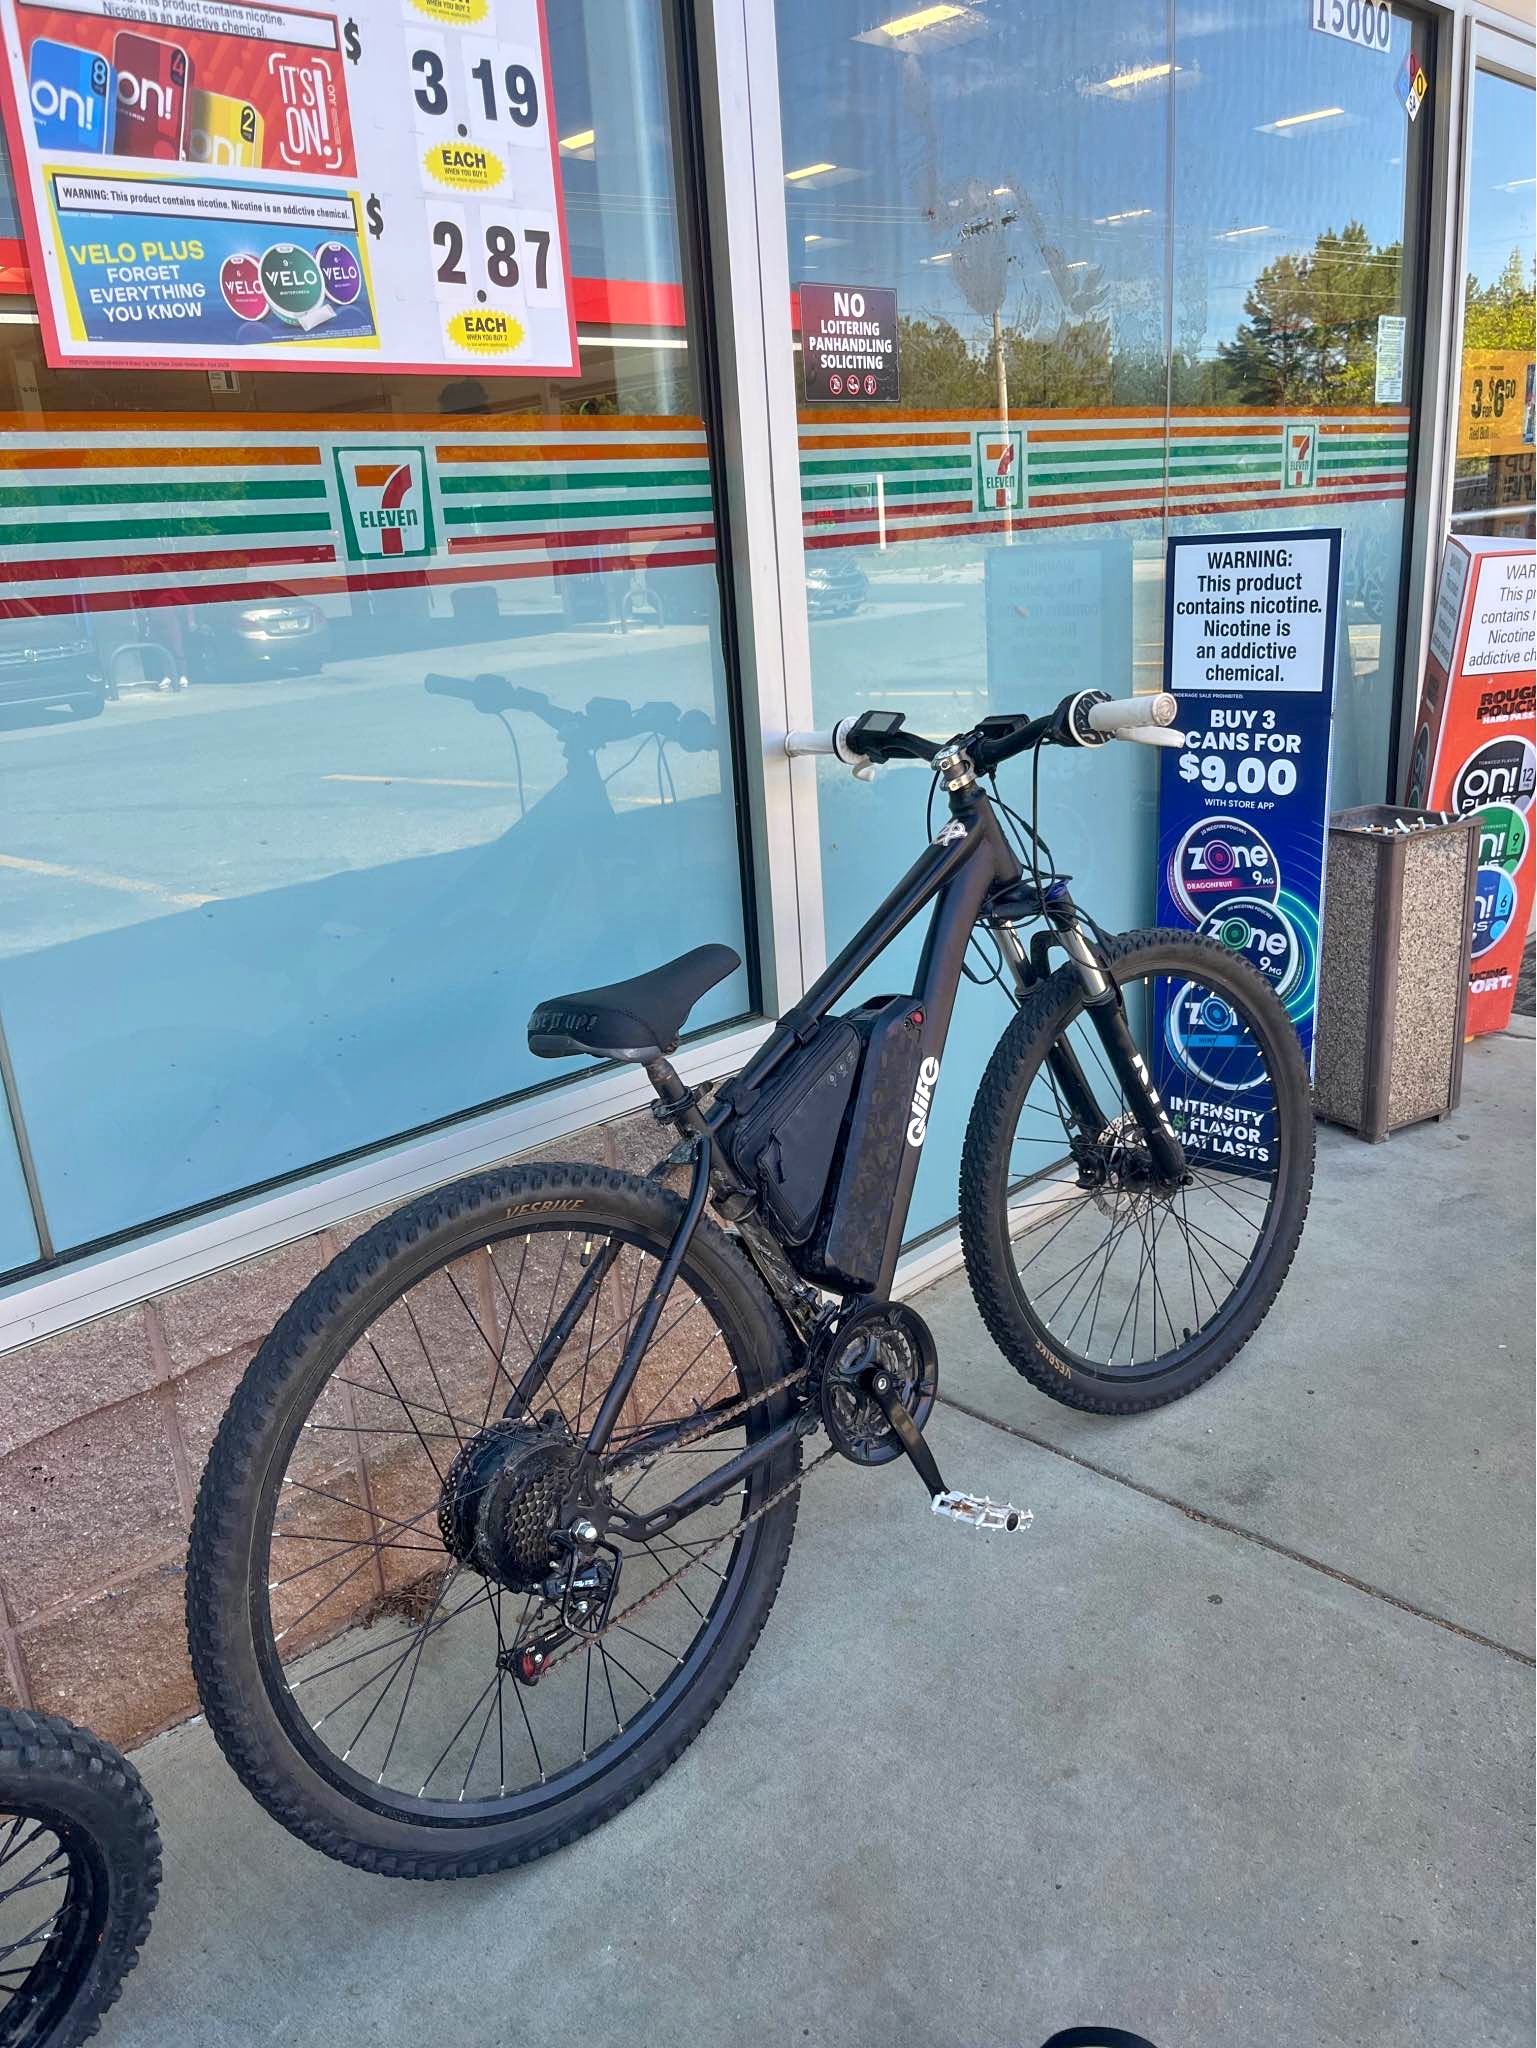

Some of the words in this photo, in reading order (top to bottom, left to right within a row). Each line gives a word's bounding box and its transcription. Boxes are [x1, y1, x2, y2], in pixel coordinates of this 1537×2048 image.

[102, 3, 147, 20] Nicotine
[149, 12, 158, 22] is
[160, 13, 174, 24] an
[175, 14, 219, 31] addictive
[222, 22, 268, 38] chemical.
[202, 4, 244, 19] contains
[245, 9, 286, 26] nicotine.
[1317, 0, 1390, 48] 15000
[93, 60, 105, 85] 8
[172, 52, 184, 76] 4
[279, 65, 313, 106] IT'S
[344, 17, 362, 65] $
[412, 49, 539, 138] 3.19
[31, 80, 94, 131] on!
[117, 70, 173, 120] on!
[242, 109, 254, 132] 2
[442, 150, 486, 169] EACH
[63, 187, 109, 201] WARNING:
[110, 190, 128, 203] This
[130, 193, 161, 205] product
[162, 195, 196, 207] contains
[197, 198, 230, 210] nicotine.
[231, 201, 263, 212] Nicotine
[272, 206, 282, 214] an
[283, 205, 315, 217] addictive
[316, 208, 350, 220] chemical.
[70, 242, 137, 266] VELO
[142, 239, 205, 262] PLUS
[366, 193, 384, 240] $
[433, 220, 550, 303] 2.87
[106, 264, 180, 284] FORGET
[265, 270, 318, 287] VELO
[323, 266, 357, 281] VELO
[89, 282, 206, 304] EVERYTHING
[102, 304, 143, 323] YOU
[146, 302, 202, 320] KNOW
[833, 291, 865, 318] NO
[464, 316, 507, 332] EACH
[820, 320, 880, 336] LOITERING
[809, 336, 892, 353] PANHANDLING
[820, 354, 883, 370] SOLICITING
[1471, 379, 1483, 419] 3
[1292, 435, 1310, 486] 7
[986, 444, 1015, 508] 7
[354, 464, 413, 555] 7
[1207, 549, 1293, 570] WARNING:
[1197, 574, 1231, 593] This
[1236, 573, 1302, 595] product
[1500, 586, 1523, 602] This
[1176, 597, 1245, 615] contains
[1250, 595, 1322, 614] nicotine.
[1481, 607, 1529, 624] contains
[1204, 619, 1271, 637] Nicotine
[1276, 619, 1291, 637] is
[1488, 628, 1536, 645] Nicotine
[1196, 645, 1216, 659] an
[1221, 642, 1297, 659] addictive
[1469, 650, 1520, 667] addictive
[1205, 664, 1285, 682] chemical.
[1210, 709, 1258, 729] BUY
[1262, 709, 1276, 730] 3
[1482, 715, 1510, 725] HARD
[1185, 730, 1250, 751] CANS
[1254, 732, 1302, 754] FOR
[1178, 751, 1297, 796] $9.00
[1463, 766, 1518, 797] on!
[1523, 768, 1534, 783] 12
[1204, 798, 1227, 808] WITH
[1228, 799, 1256, 810] STORE
[1258, 801, 1275, 811] APP
[1478, 831, 1506, 859] n!
[1513, 832, 1520, 847] 9
[1188, 840, 1268, 876] zone
[1186, 880, 1233, 890] DRAGONFRUIT
[1475, 894, 1494, 920] n!
[1500, 895, 1507, 909] 6
[1206, 917, 1288, 956] zone
[1468, 975, 1512, 994] ORT.
[1170, 1095, 1265, 1127] INTENSITY
[1190, 1116, 1261, 1144] FLAVOR
[1174, 1130, 1209, 1150] HAT
[1212, 1138, 1270, 1162] LASTS
